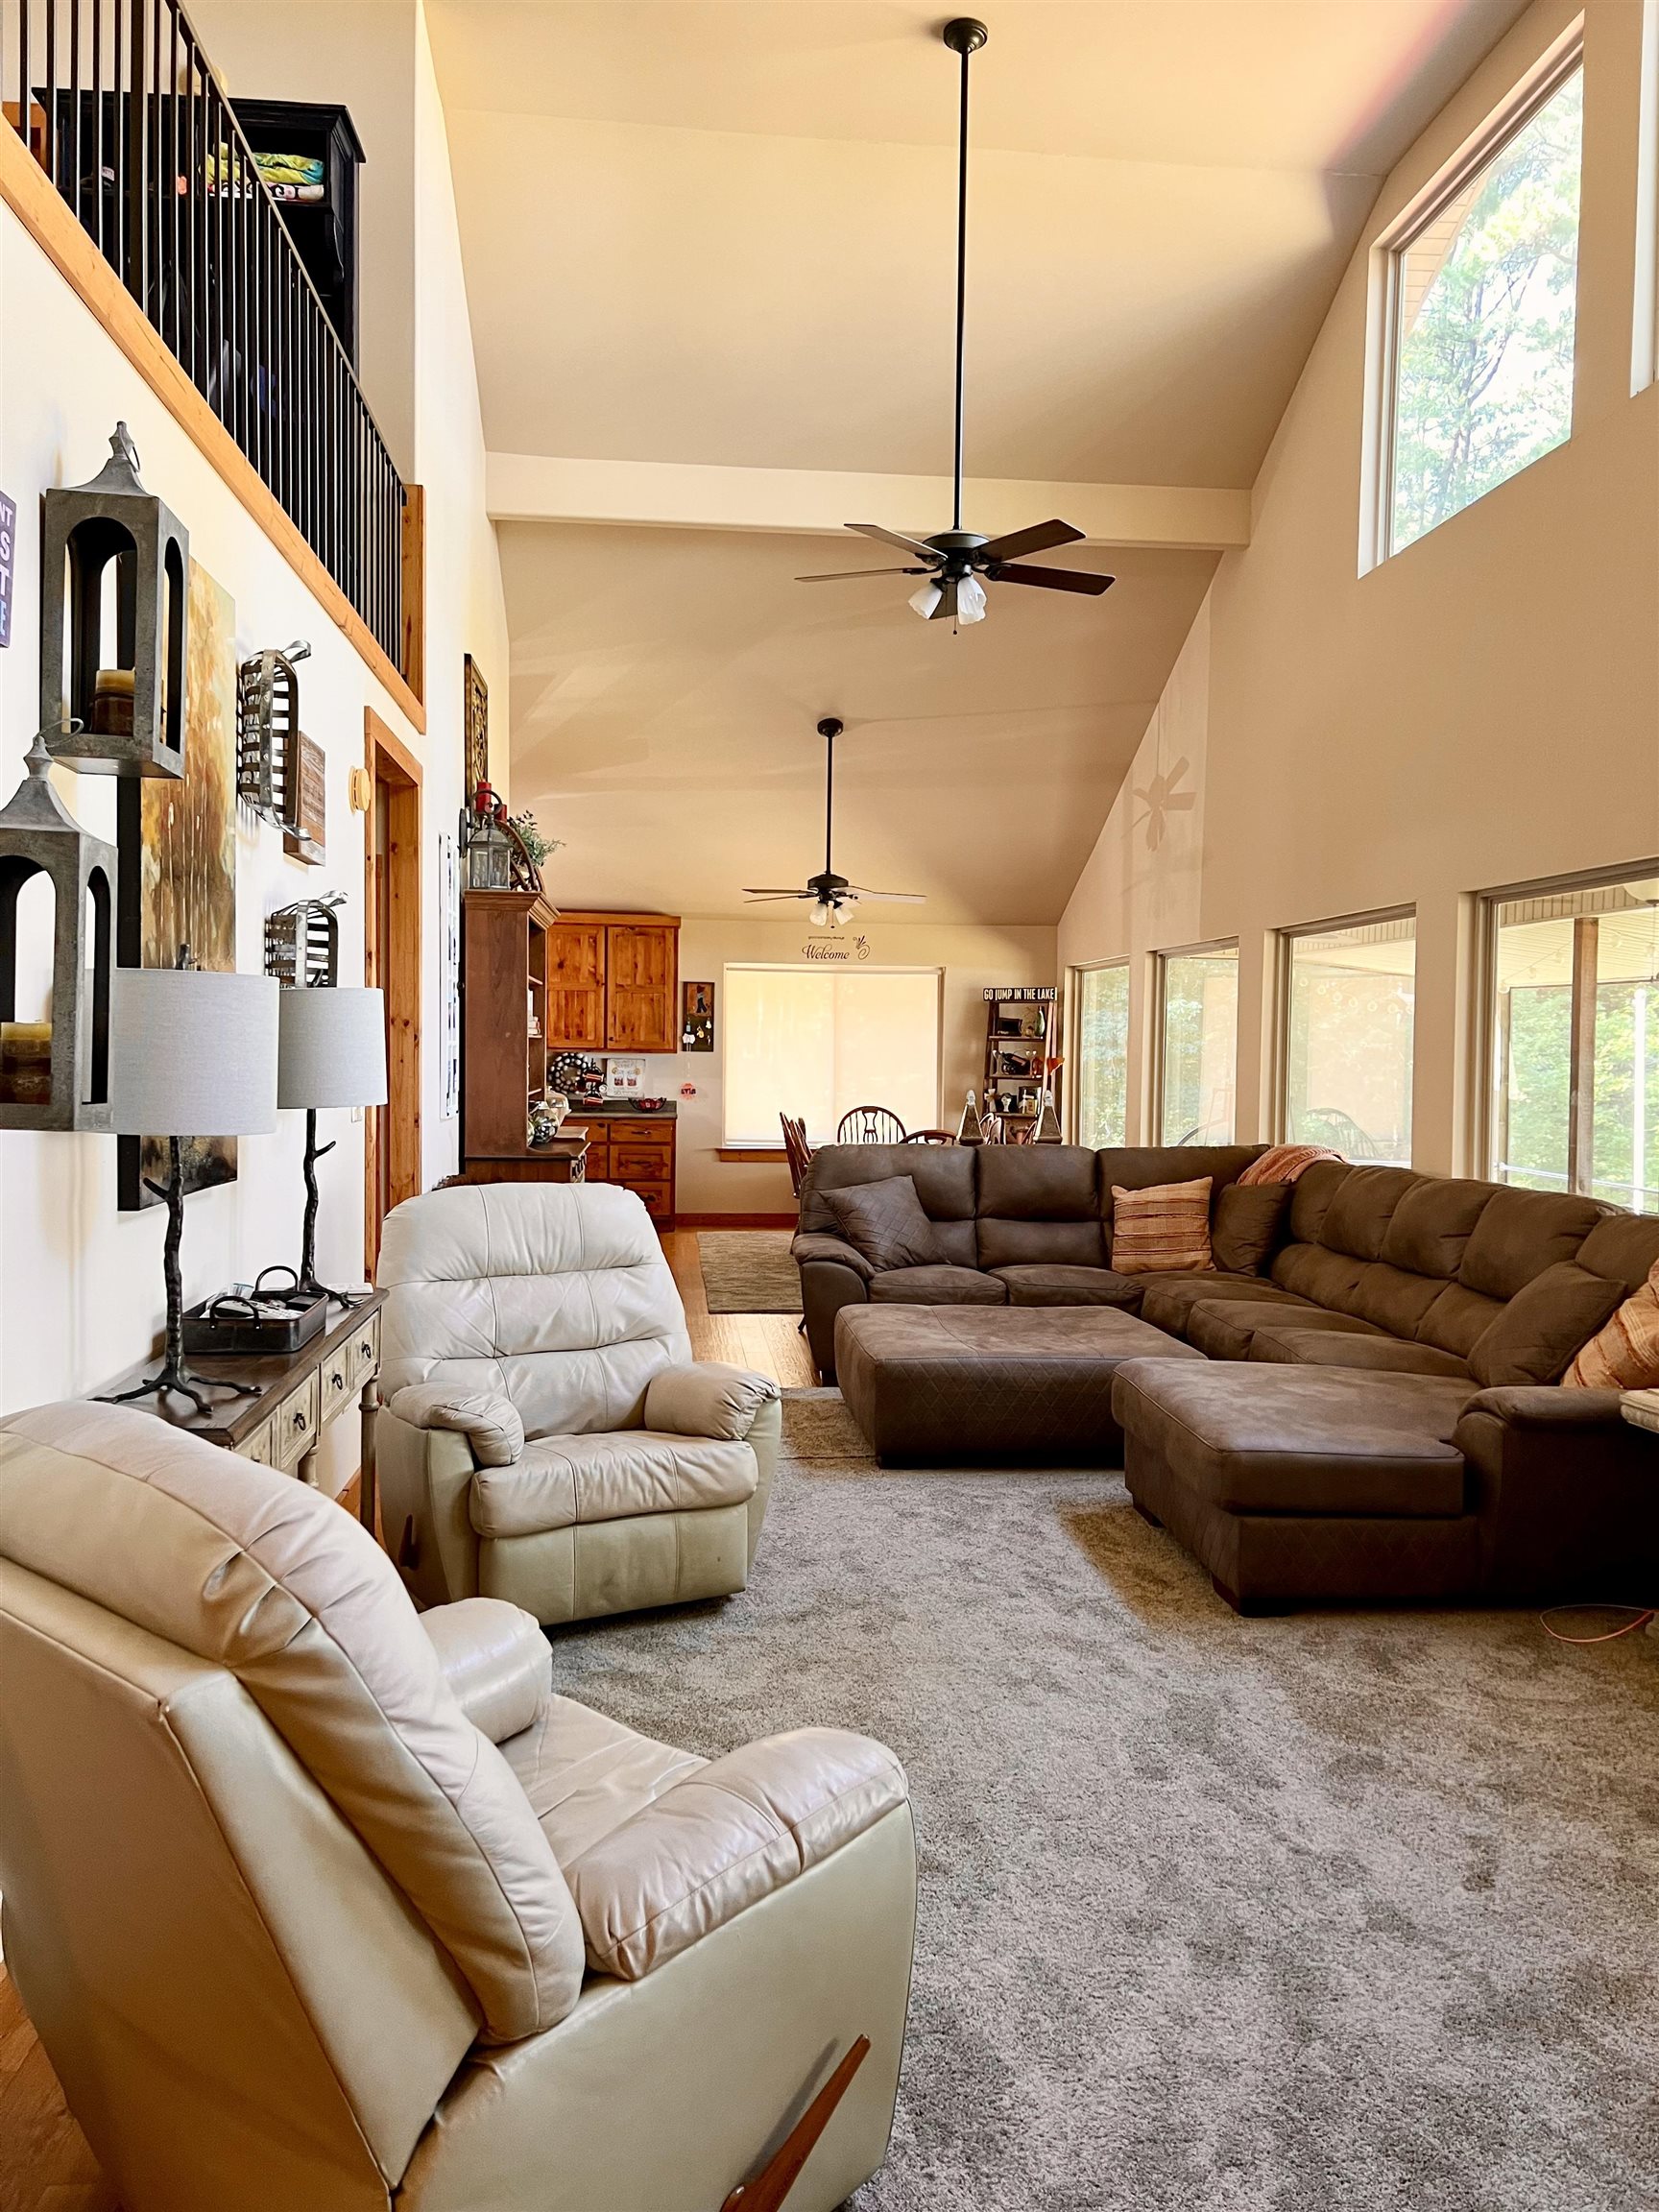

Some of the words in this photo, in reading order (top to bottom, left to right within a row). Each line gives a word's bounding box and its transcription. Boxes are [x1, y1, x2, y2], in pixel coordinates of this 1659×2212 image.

[802, 944, 850, 959] Welcome
[984, 989, 994, 1000] GO
[995, 989, 1013, 1001] JUMP
[1014, 989, 1022, 1000] IN
[1023, 989, 1036, 1000] THE
[1037, 988, 1054, 1000] LAKE
